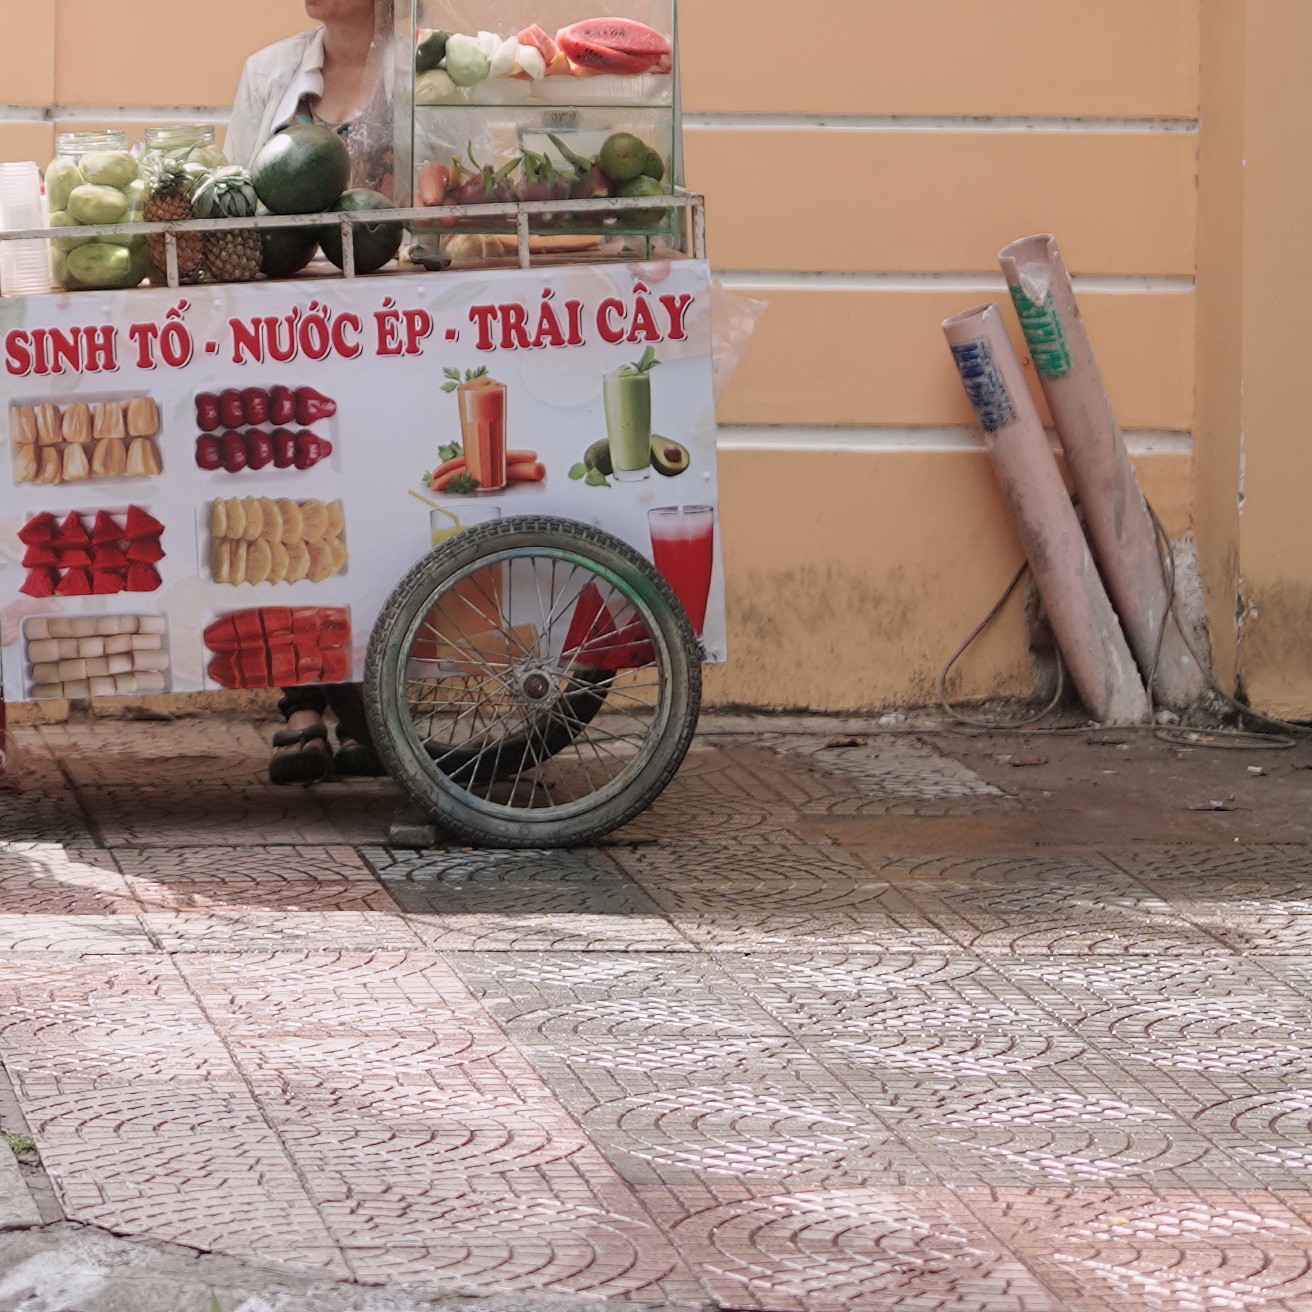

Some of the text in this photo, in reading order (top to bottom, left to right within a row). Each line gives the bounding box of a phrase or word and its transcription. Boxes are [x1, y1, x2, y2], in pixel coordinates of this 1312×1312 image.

[4, 324, 119, 377] SINH
[128, 299, 193, 369] TỐ
[228, 300, 362, 365] NƯỚC
[372, 296, 433, 357] ÉP
[467, 287, 585, 352] TRÁI
[595, 282, 693, 345] CÂY
